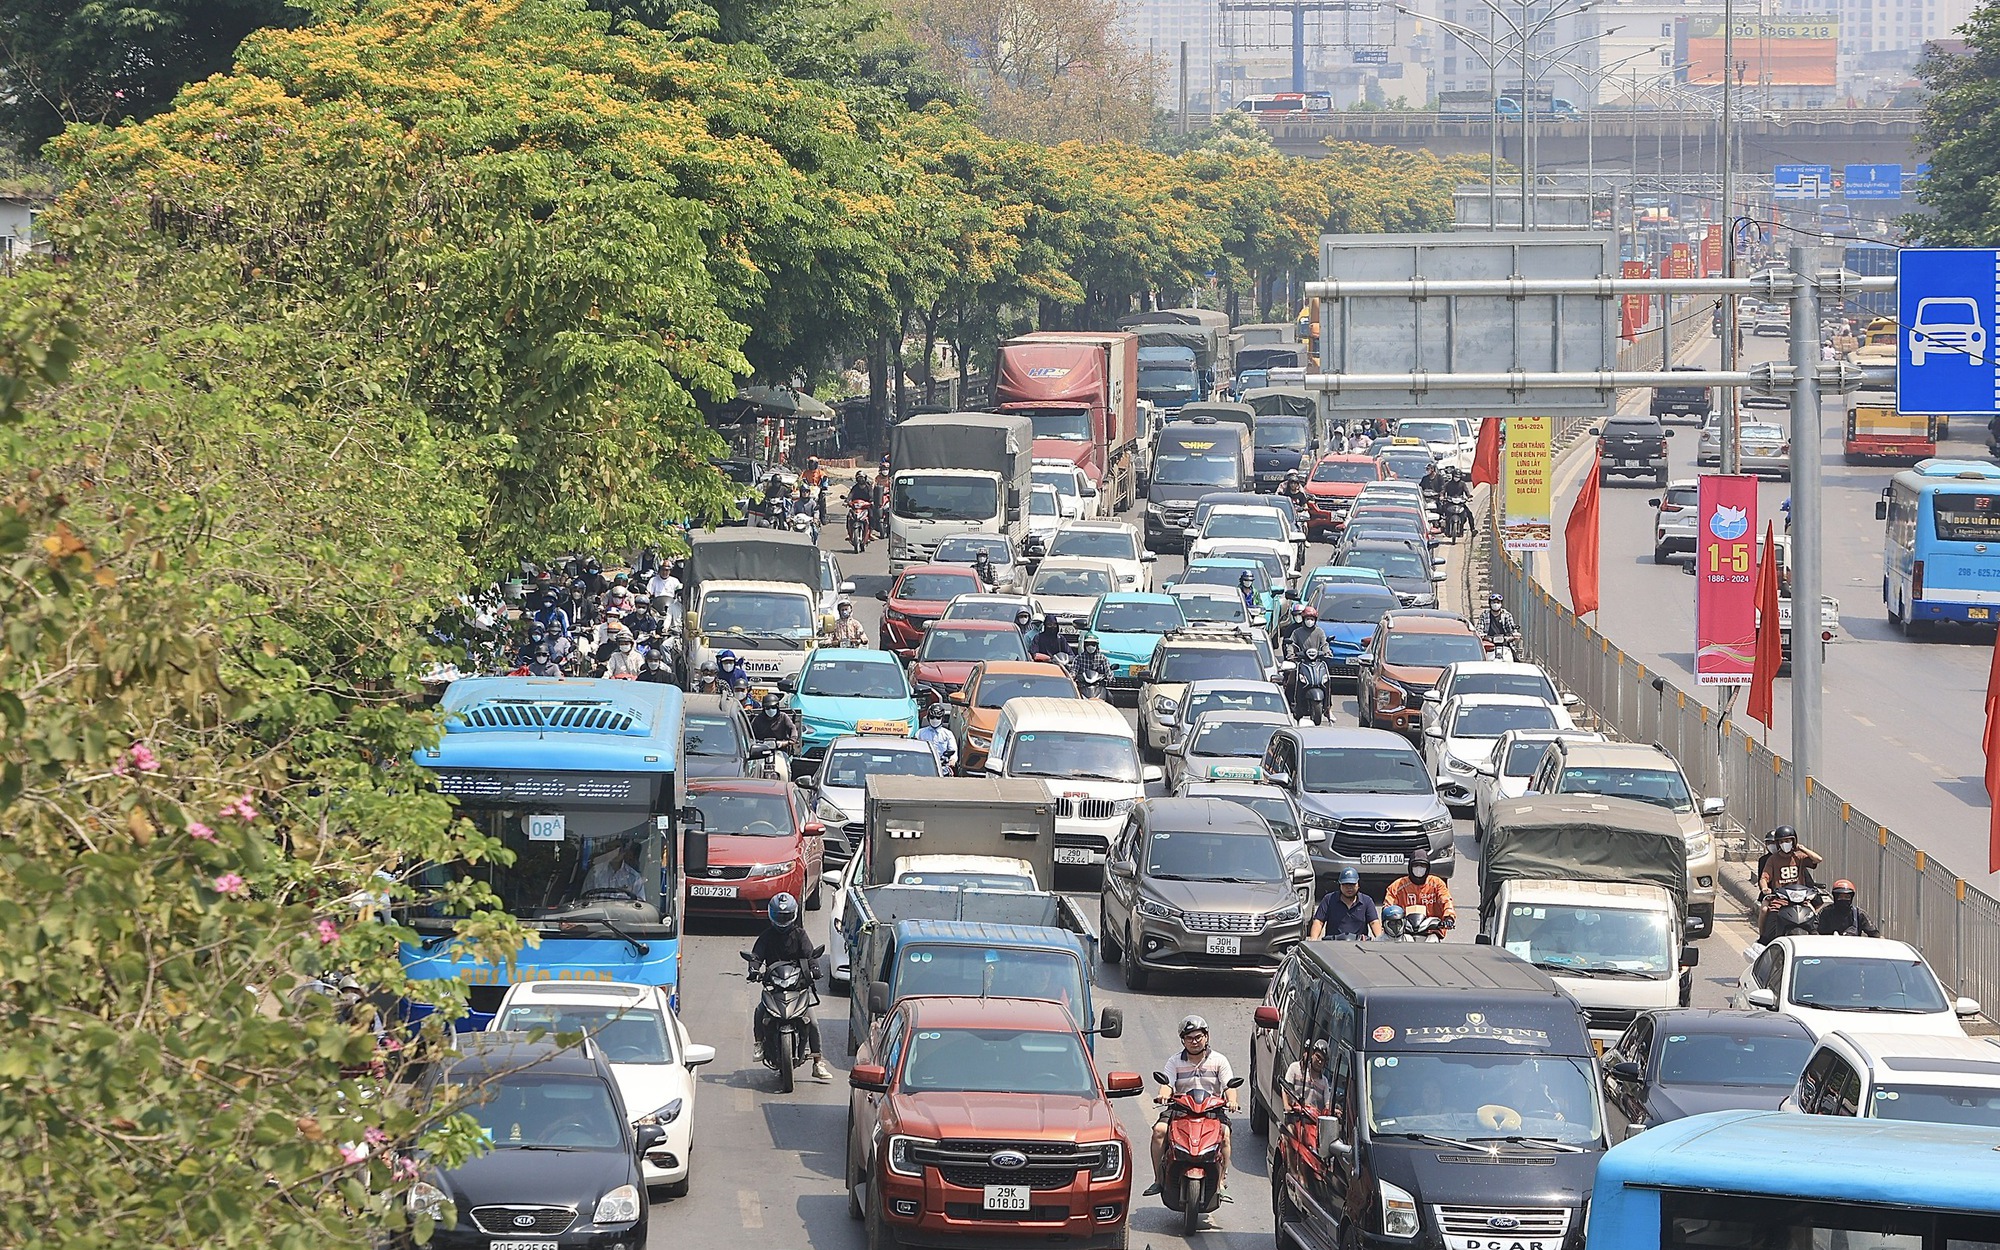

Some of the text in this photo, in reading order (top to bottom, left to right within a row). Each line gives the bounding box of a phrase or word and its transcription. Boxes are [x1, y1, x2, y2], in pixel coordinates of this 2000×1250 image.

[1802, 27, 1829, 36] 218
[1708, 543, 1749, 573] 1-5
[745, 663, 779, 671] SIMBA
[694, 886, 732, 896] 30U-7312
[460, 968, 499, 984] BUS
[1406, 1026, 1548, 1038] LIMOUSINE
[1000, 1156, 1018, 1166] Ford
[998, 1188, 1017, 1197] 29K
[989, 1198, 1024, 1208] 018.03
[1494, 1218, 1513, 1226] Ford
